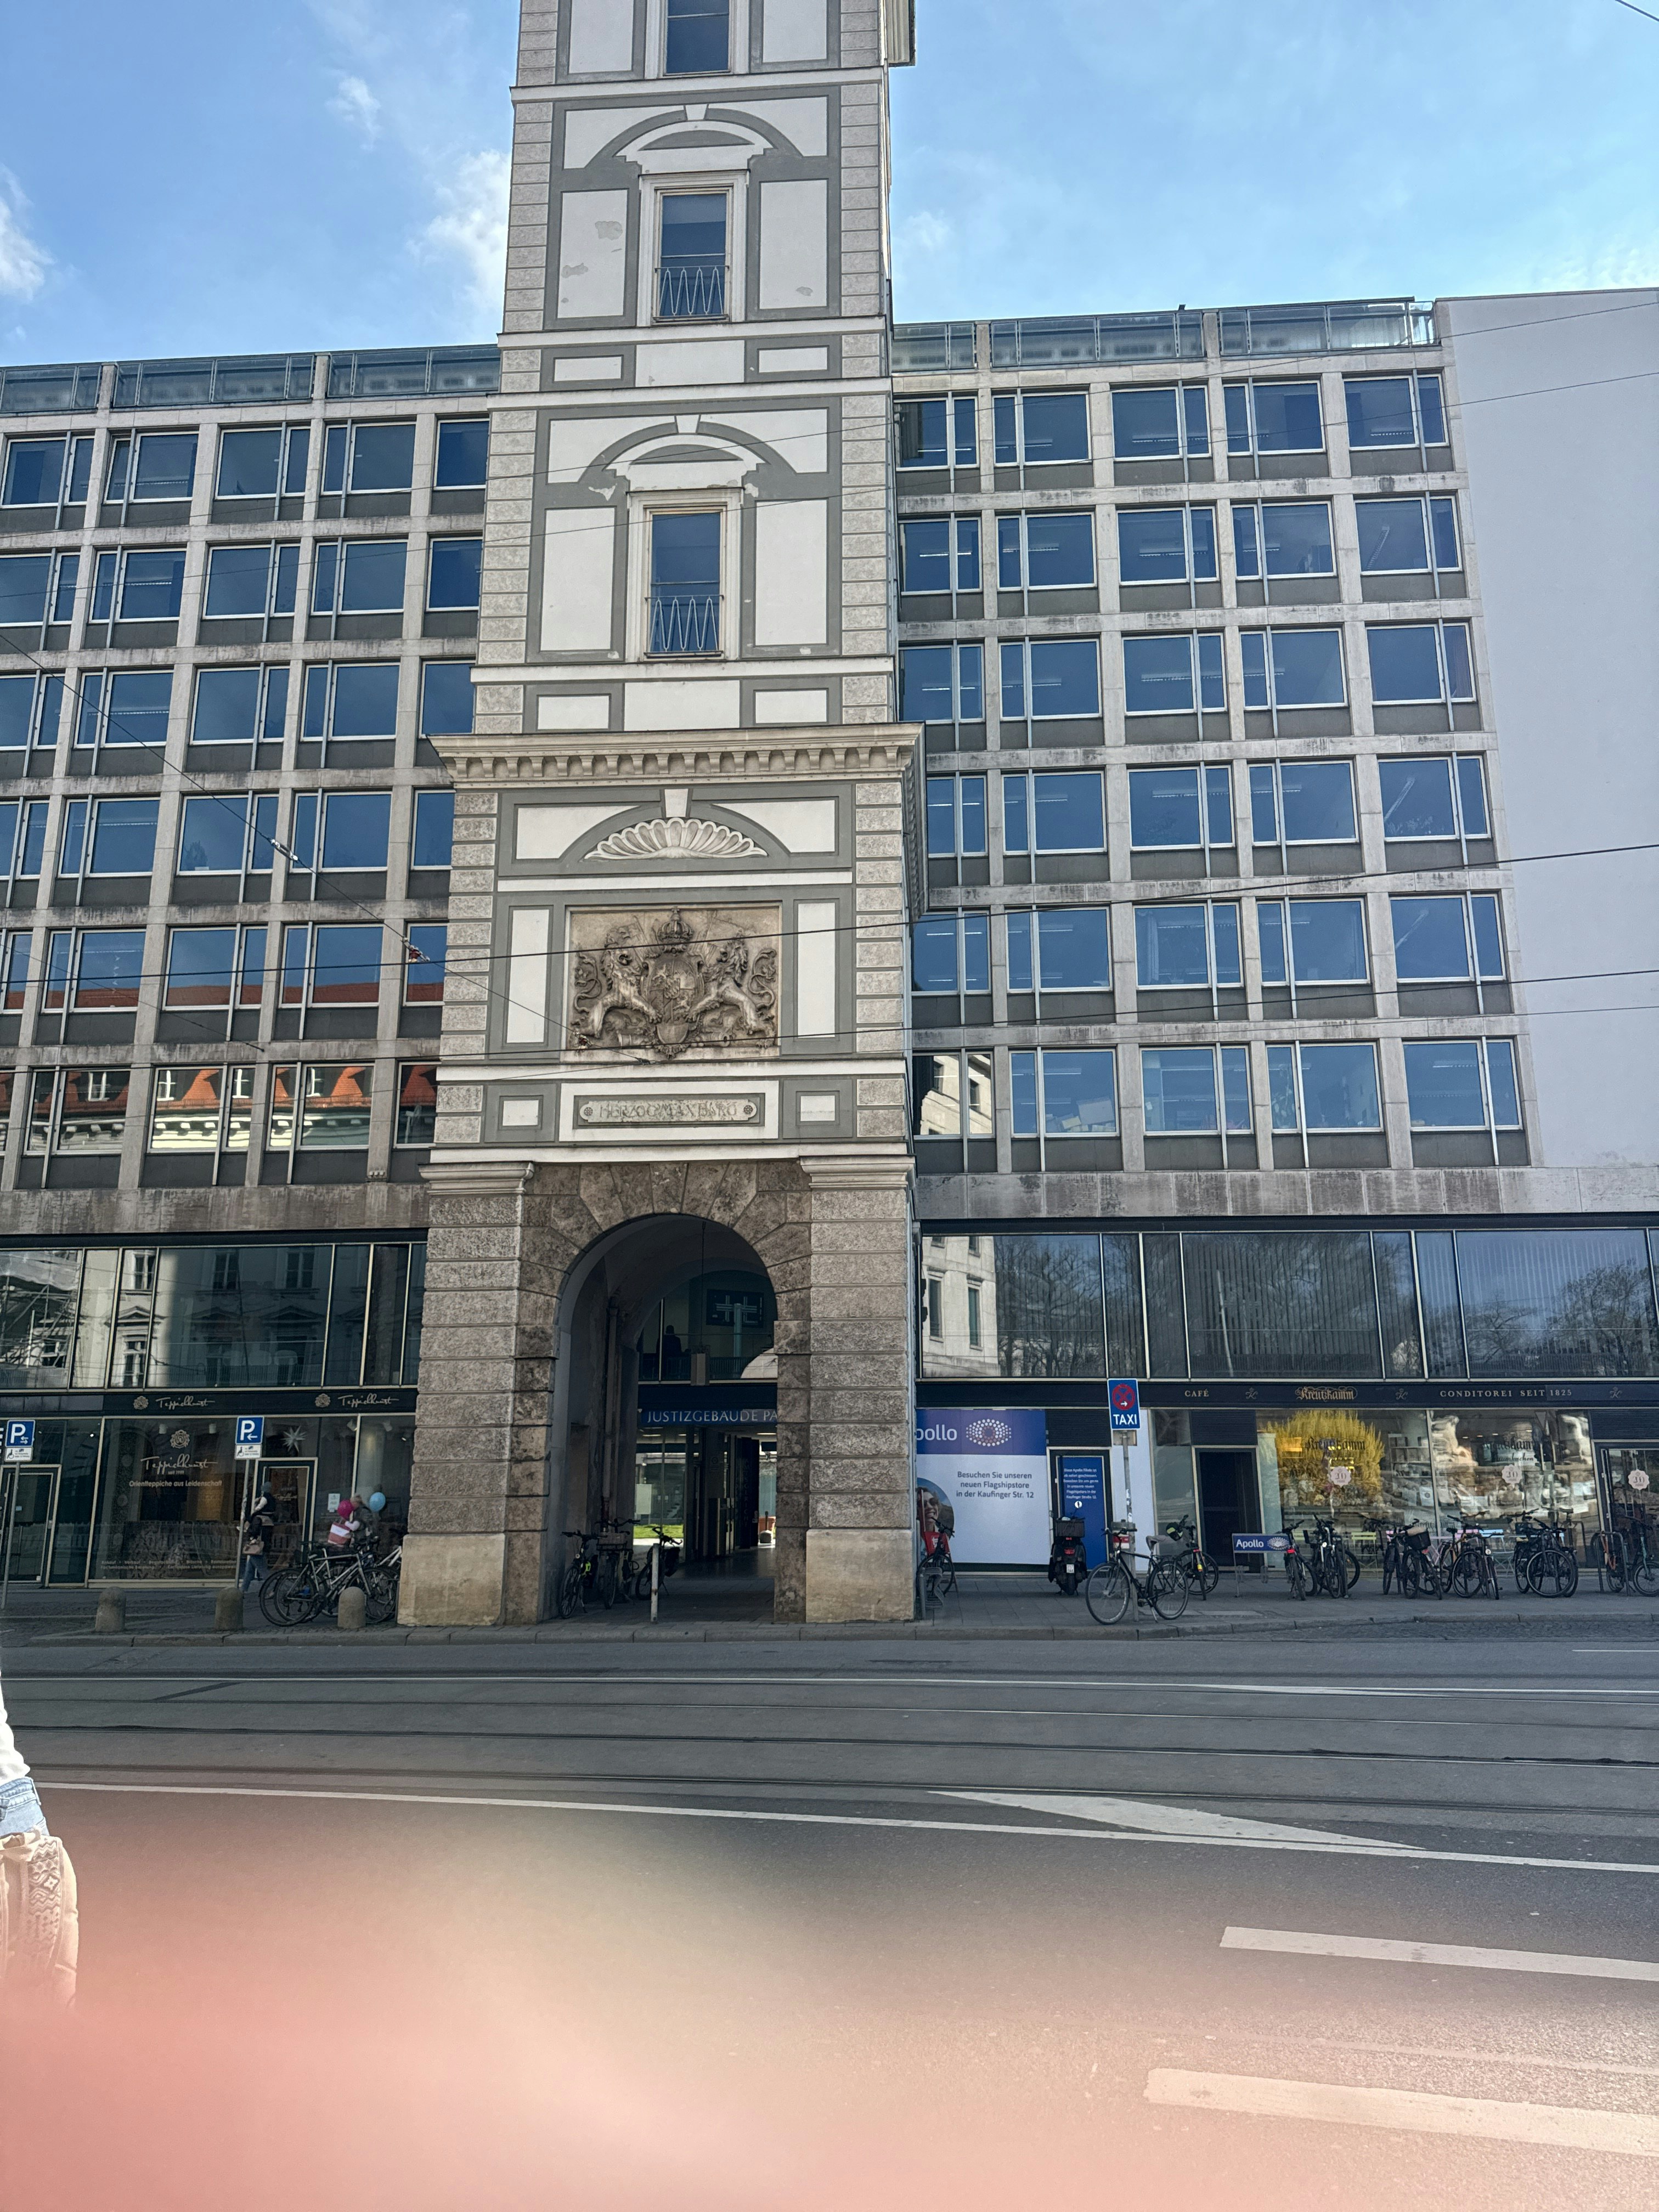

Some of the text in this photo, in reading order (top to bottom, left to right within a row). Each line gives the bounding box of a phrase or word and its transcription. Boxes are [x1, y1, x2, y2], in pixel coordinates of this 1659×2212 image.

[1184, 1389, 1210, 1397] CAFÉ
[1440, 1390, 1512, 1398] CONDITOREI
[155, 1396, 215, 1410] Teppichkunst
[338, 1393, 399, 1408] Teppichkunst
[647, 1410, 758, 1423] JUSTIZGEBÄUDE
[1113, 1414, 1137, 1425] TAXI
[10, 1424, 26, 1444] P
[240, 1420, 255, 1441] P
[140, 1453, 218, 1475] Teppichkunst
[984, 1481, 1030, 1489] Flagshipstore
[978, 1491, 1011, 1499] Kaufinger
[1236, 1539, 1264, 1549] Apollo
